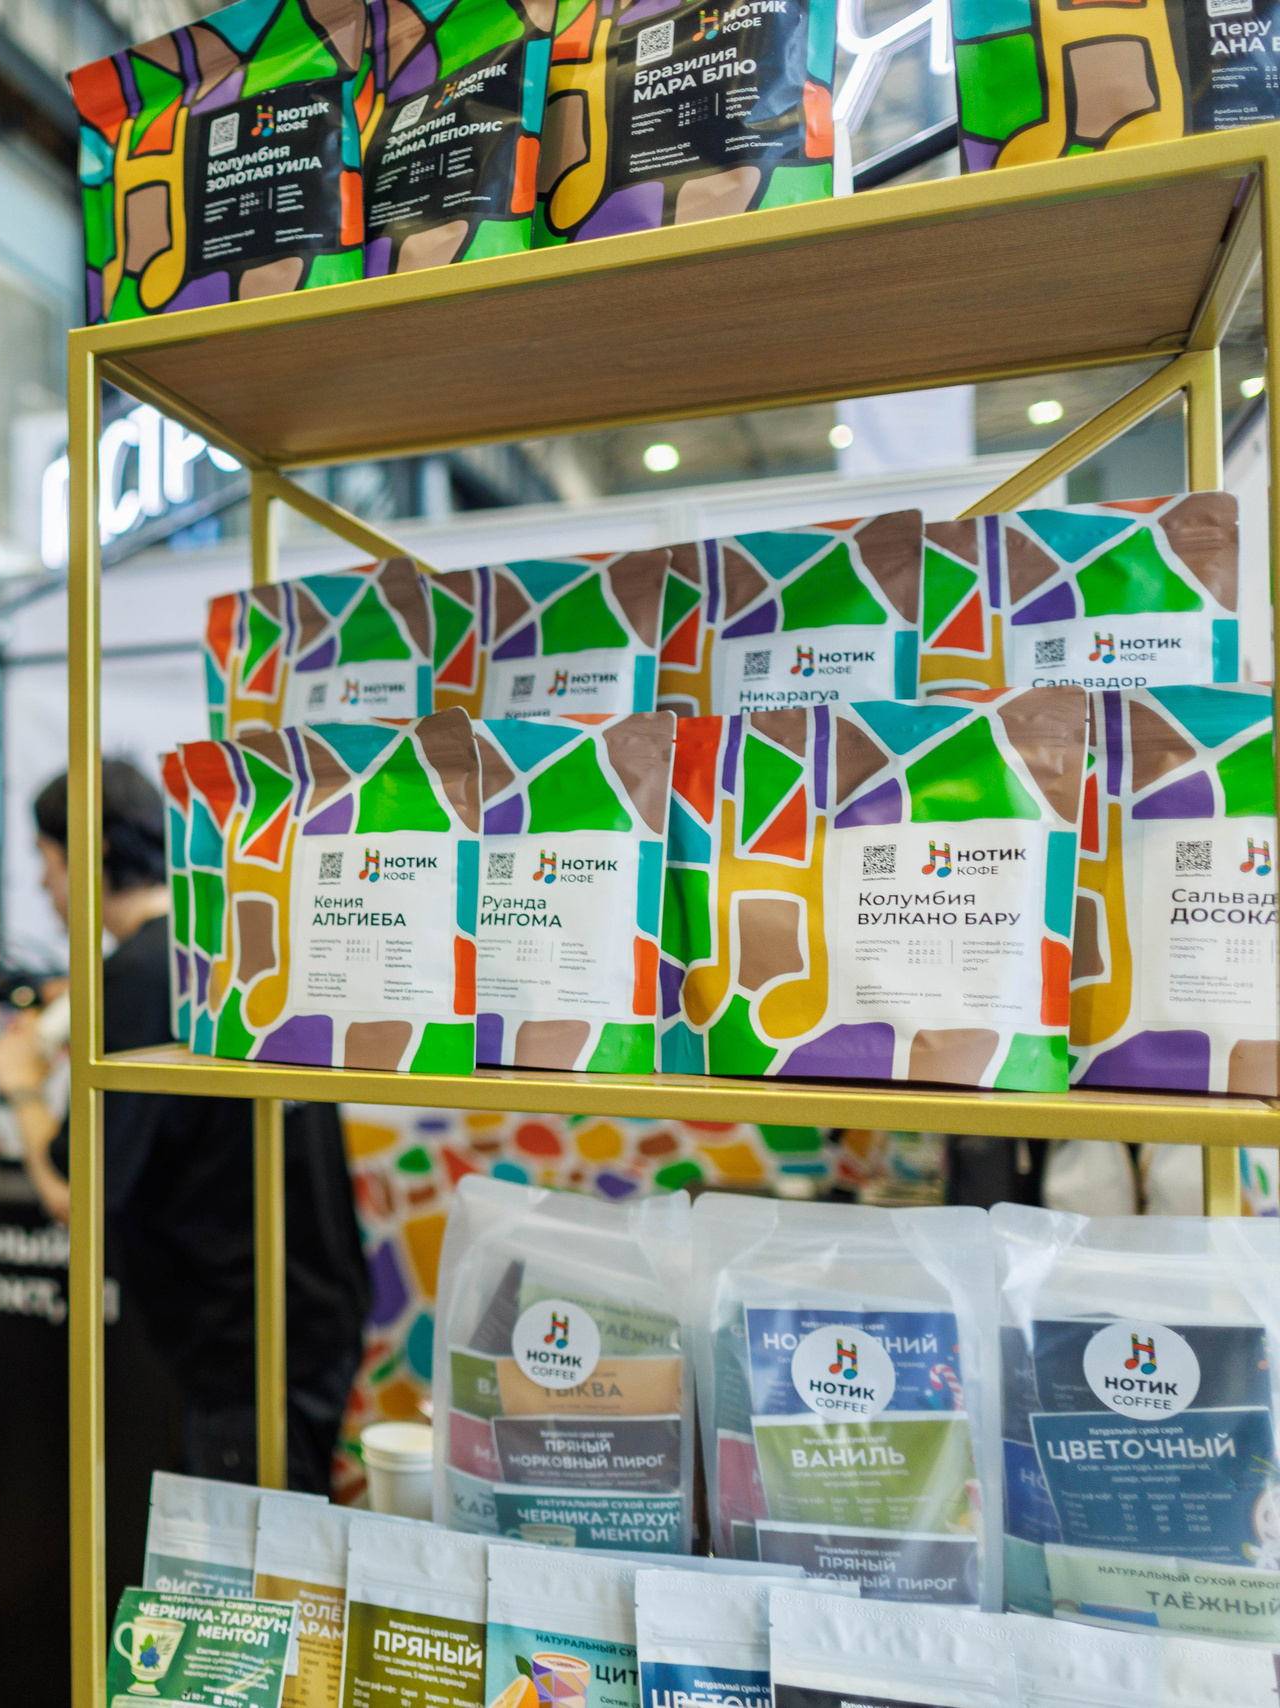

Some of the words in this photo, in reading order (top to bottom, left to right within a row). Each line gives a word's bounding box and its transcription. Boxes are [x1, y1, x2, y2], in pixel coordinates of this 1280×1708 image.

[723, 1, 787, 22] НОТИК
[722, 17, 762, 34] КОФЕ
[1209, 20, 1272, 38] Перу
[1210, 36, 1266, 55] АНА
[634, 47, 737, 86] Бразилия
[457, 63, 508, 90] НОТИК
[633, 74, 697, 103] МАРА
[702, 59, 757, 84] БЛЮ
[453, 82, 485, 99] КОФЕ
[276, 102, 329, 122] НОТИК
[276, 119, 309, 133] КОФЕ
[381, 139, 427, 165] ГАММА
[428, 120, 503, 146] ЛЕПОРИС
[207, 146, 290, 176] Колумбия
[206, 164, 274, 192] ЗОЛОТАЯ
[276, 156, 322, 175] УИЛА
[1120, 637, 1182, 649] НОТИК
[819, 651, 875, 663] НОТИК
[1120, 652, 1157, 662] КОФЕ
[570, 672, 619, 685] НОТИК
[819, 666, 852, 675] КОФЕ
[739, 688, 839, 705] Никарагуа
[384, 857, 438, 868] НОТИК
[957, 848, 1027, 862] НОТИК
[561, 859, 618, 871] НОТИК
[957, 866, 999, 876] КОФЕ
[383, 872, 416, 881] КОФЕ
[560, 874, 595, 884] КОФЕ
[314, 895, 363, 908] Кения
[482, 895, 547, 911] Руанда
[859, 890, 975, 909] Колумбия
[312, 913, 407, 927] АЛЬГИЕБА
[480, 913, 562, 928] ИНГОМА
[858, 912, 957, 925] ВУЛКАНО
[965, 913, 1021, 925] БАРУ
[527, 1349, 582, 1369] НОТИК
[531, 1365, 576, 1381] COFFEE
[810, 1379, 875, 1401] НОТИК
[1104, 1376, 1179, 1396] НОТИК
[815, 1397, 869, 1415] COFFEE
[1113, 1395, 1172, 1411] COFFEE
[544, 1437, 611, 1453] ПРЯНЫЙ
[1047, 1433, 1237, 1463] ЦВЕТОЧНЫЙ
[612, 1454, 666, 1468] ПИРОГ
[791, 1446, 906, 1469] ВАНИЛЬ
[590, 1528, 669, 1543] МЕНТОЛ
[820, 1556, 896, 1572] ПРЯНЫЙ
[897, 1577, 957, 1591] ПИРОГ
[1098, 1565, 1191, 1584] НАТУРАЛЬНЫЙ
[1194, 1575, 1236, 1588] СУХОЙ
[197, 1623, 270, 1648] МЕНТОЛ
[373, 1629, 483, 1669] ПРЯНЫЙ
[536, 1633, 617, 1655] НАТУРАЛЬНЫЙ
